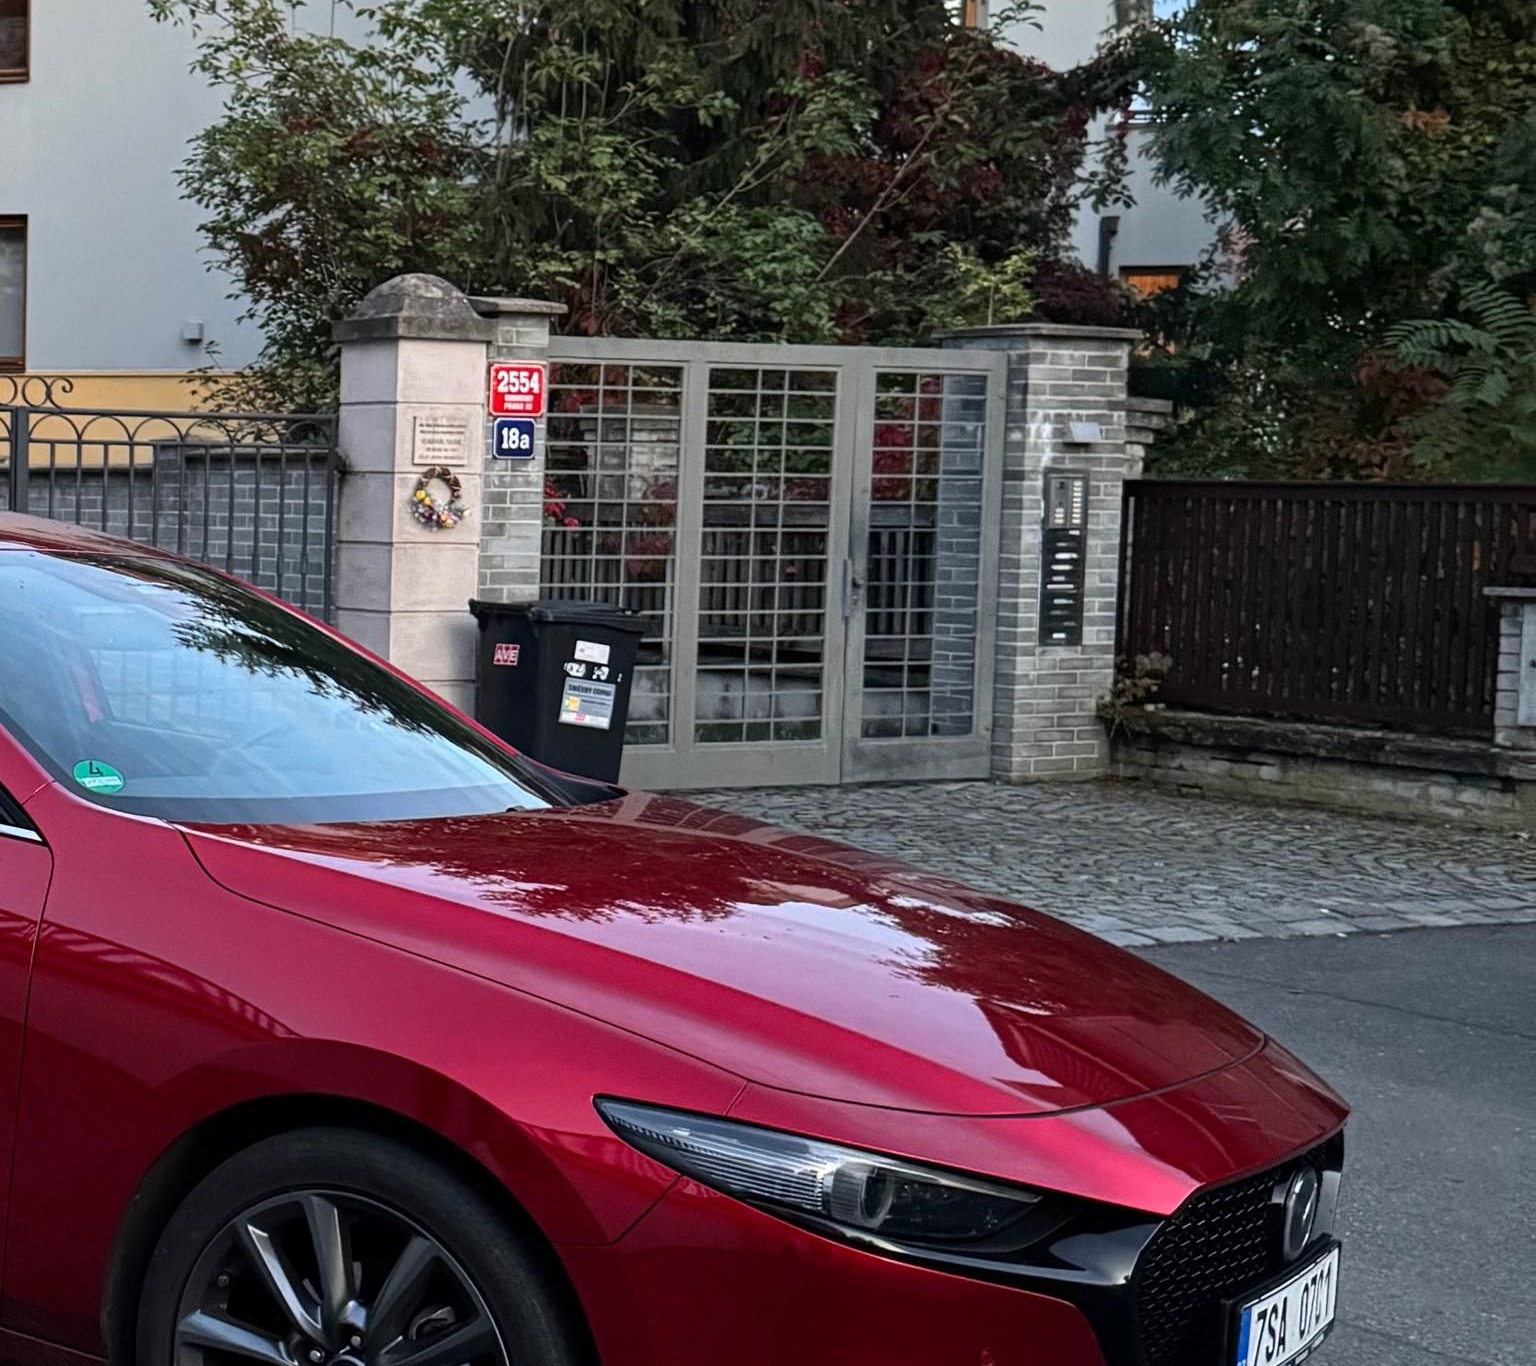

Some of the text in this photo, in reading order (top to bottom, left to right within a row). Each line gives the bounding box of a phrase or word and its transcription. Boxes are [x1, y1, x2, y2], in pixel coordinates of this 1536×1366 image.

[497, 371, 540, 394] 2554
[501, 427, 530, 449] 18a
[495, 647, 519, 663] AVE
[89, 761, 104, 776] 4
